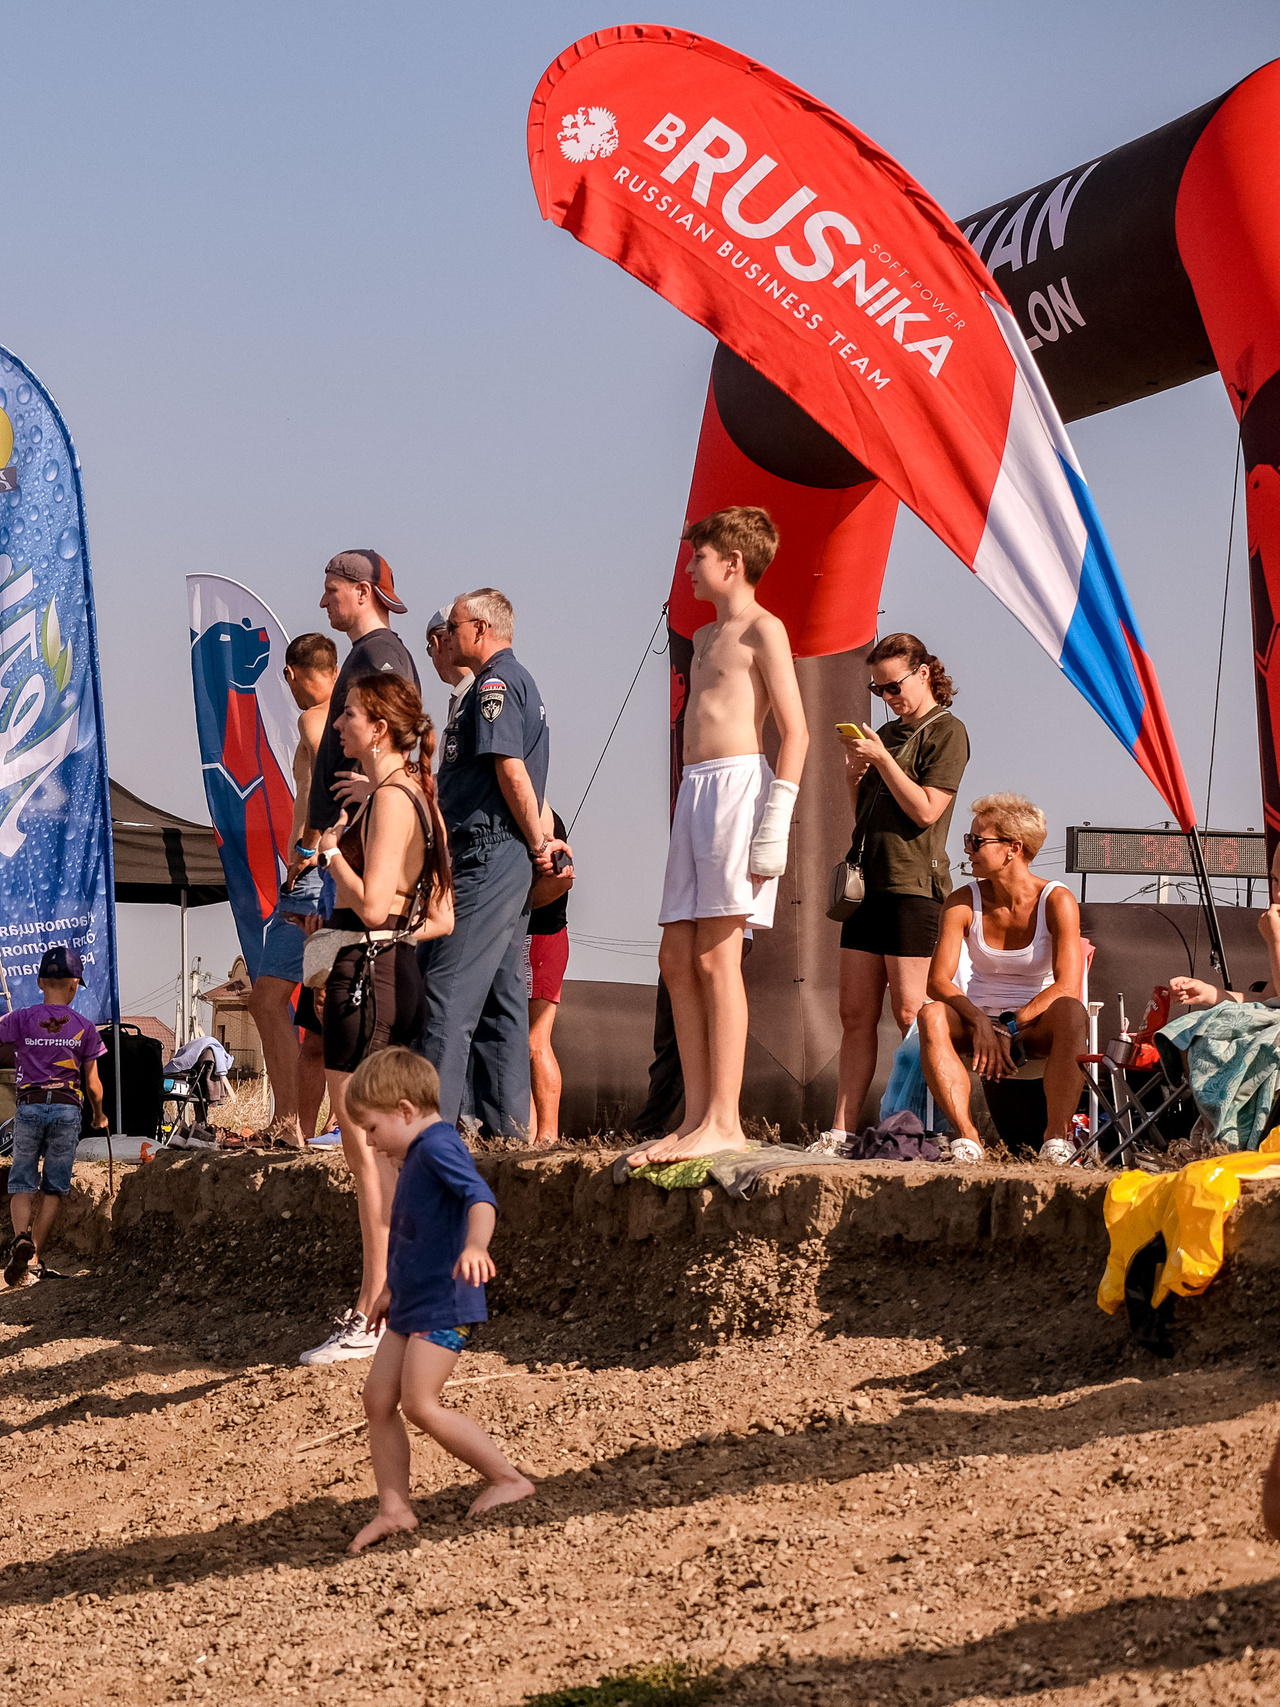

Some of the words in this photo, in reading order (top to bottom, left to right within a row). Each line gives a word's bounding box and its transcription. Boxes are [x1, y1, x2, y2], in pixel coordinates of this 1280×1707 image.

[613, 165, 715, 243] RUSSIAN
[716, 240, 823, 330] BUSINESS
[828, 330, 891, 390] TEAM
[643, 112, 953, 378] BRUSNIKA
[869, 243, 910, 278] SOFT
[910, 280, 966, 331] POWER
